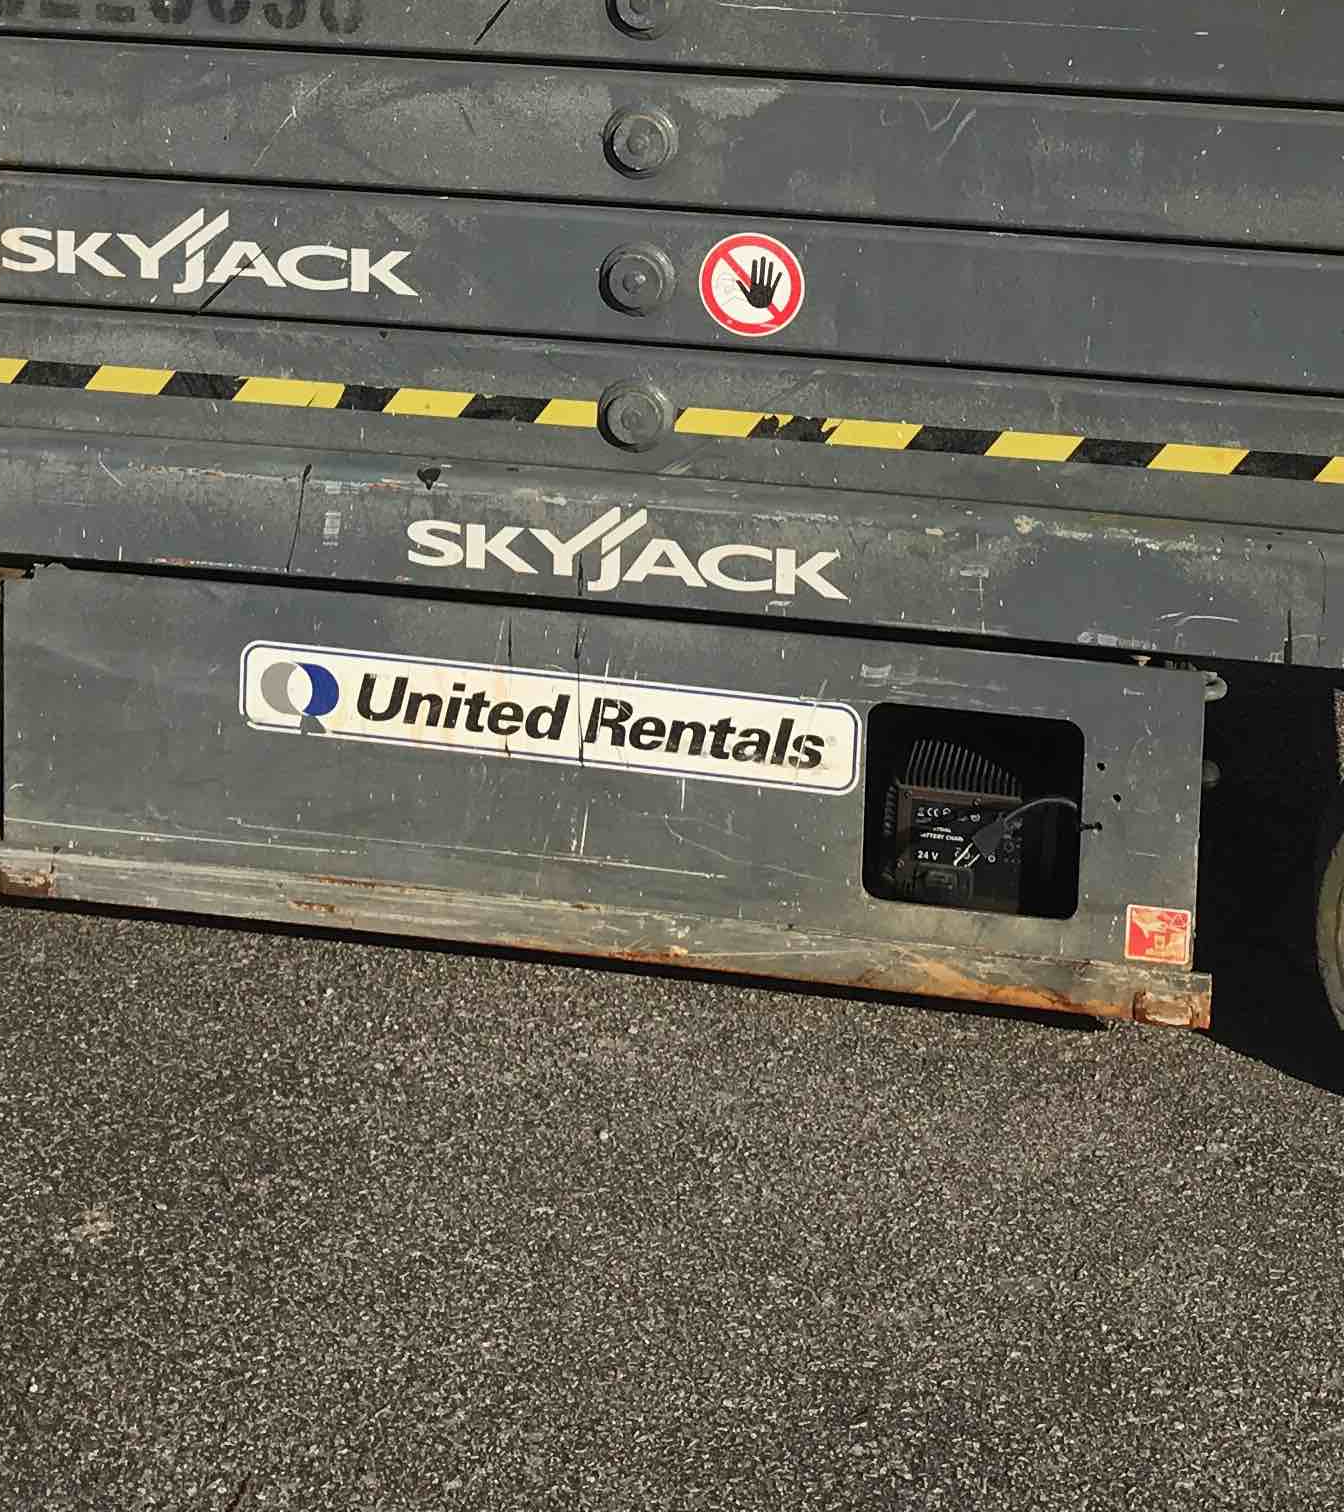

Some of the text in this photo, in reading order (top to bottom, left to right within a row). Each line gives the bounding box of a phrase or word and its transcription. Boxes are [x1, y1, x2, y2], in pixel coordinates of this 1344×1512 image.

[0, 207, 421, 298] SKYJACK
[406, 506, 850, 601] SKYJACK
[356, 672, 828, 770] United Rentals
